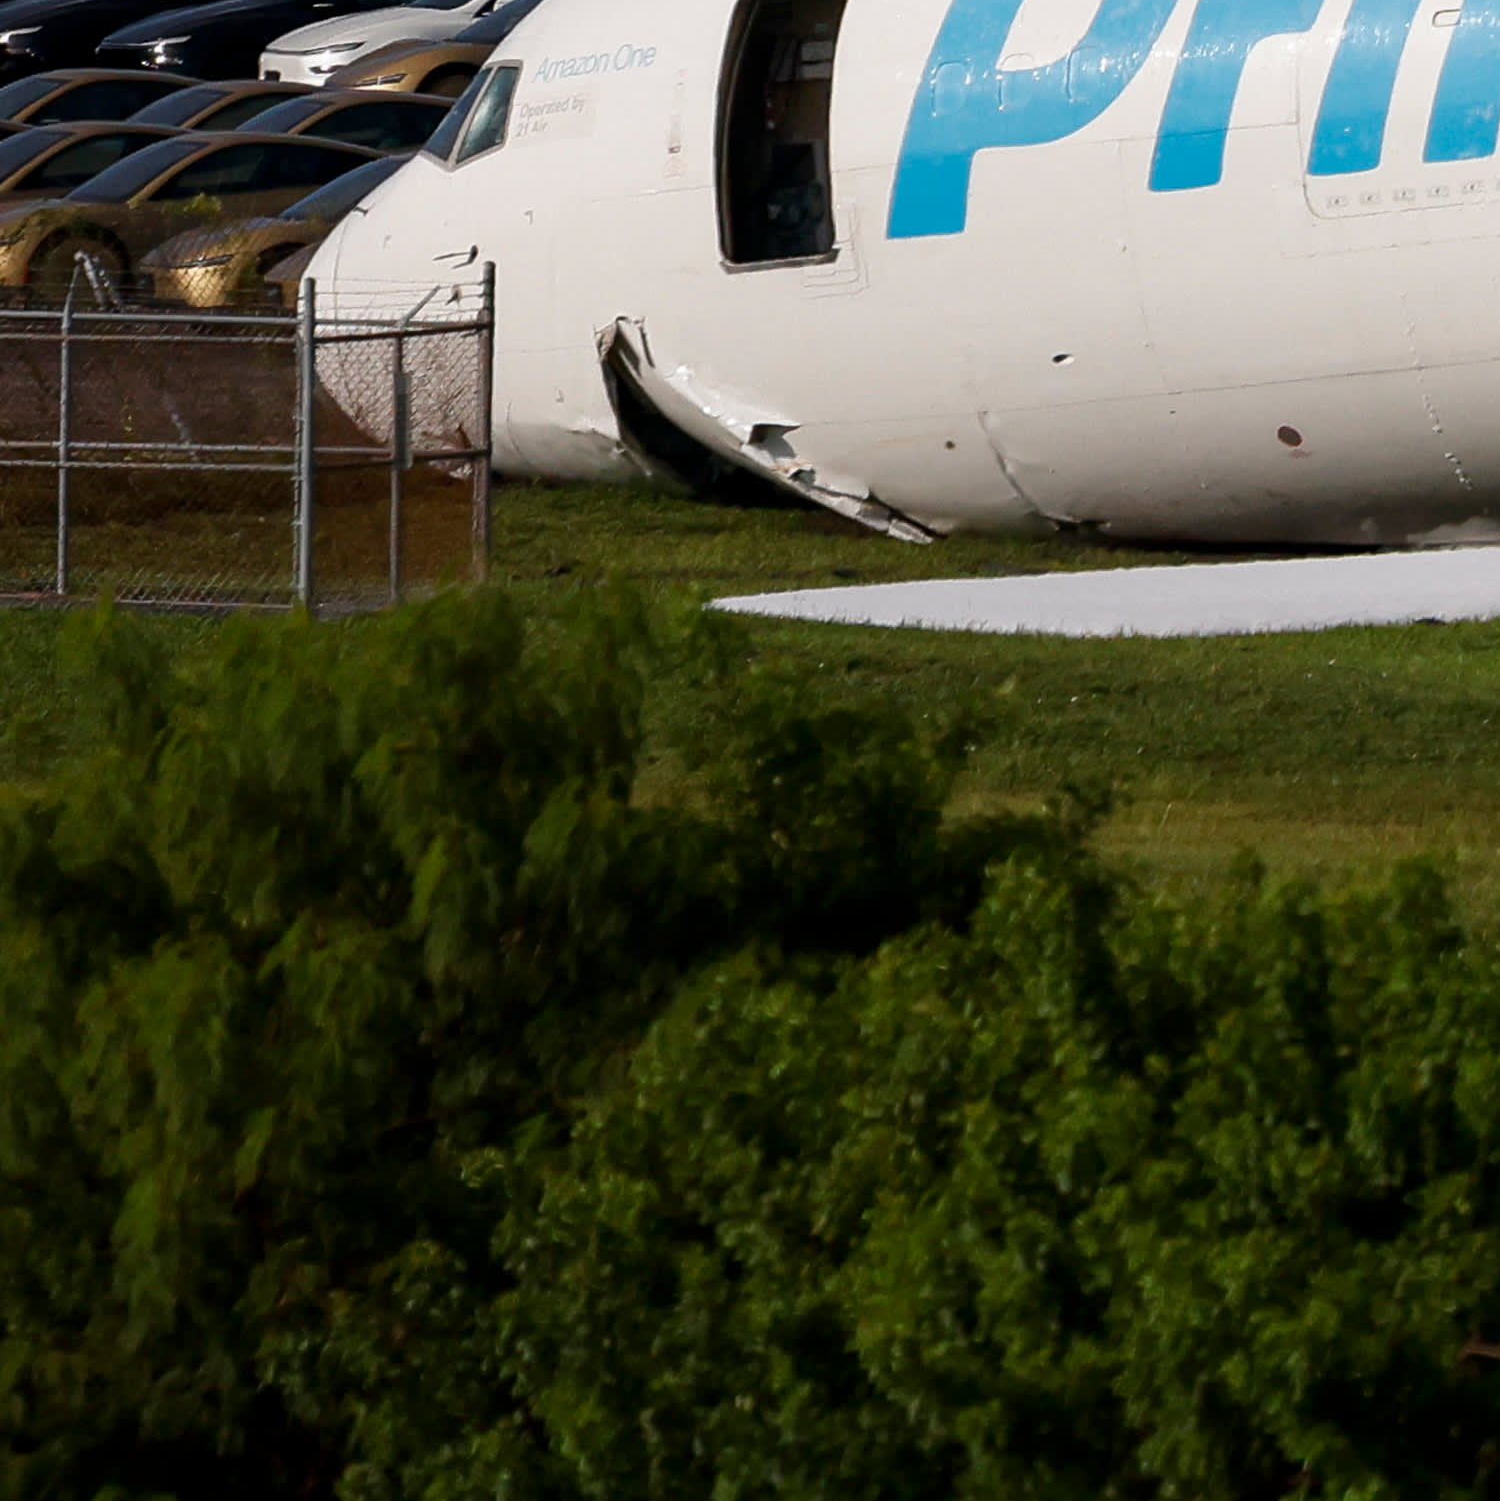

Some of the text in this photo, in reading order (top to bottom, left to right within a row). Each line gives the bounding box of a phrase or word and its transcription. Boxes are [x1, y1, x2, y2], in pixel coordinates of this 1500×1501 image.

[532, 43, 657, 83] Amazon One
[519, 95, 586, 120] Operated by
